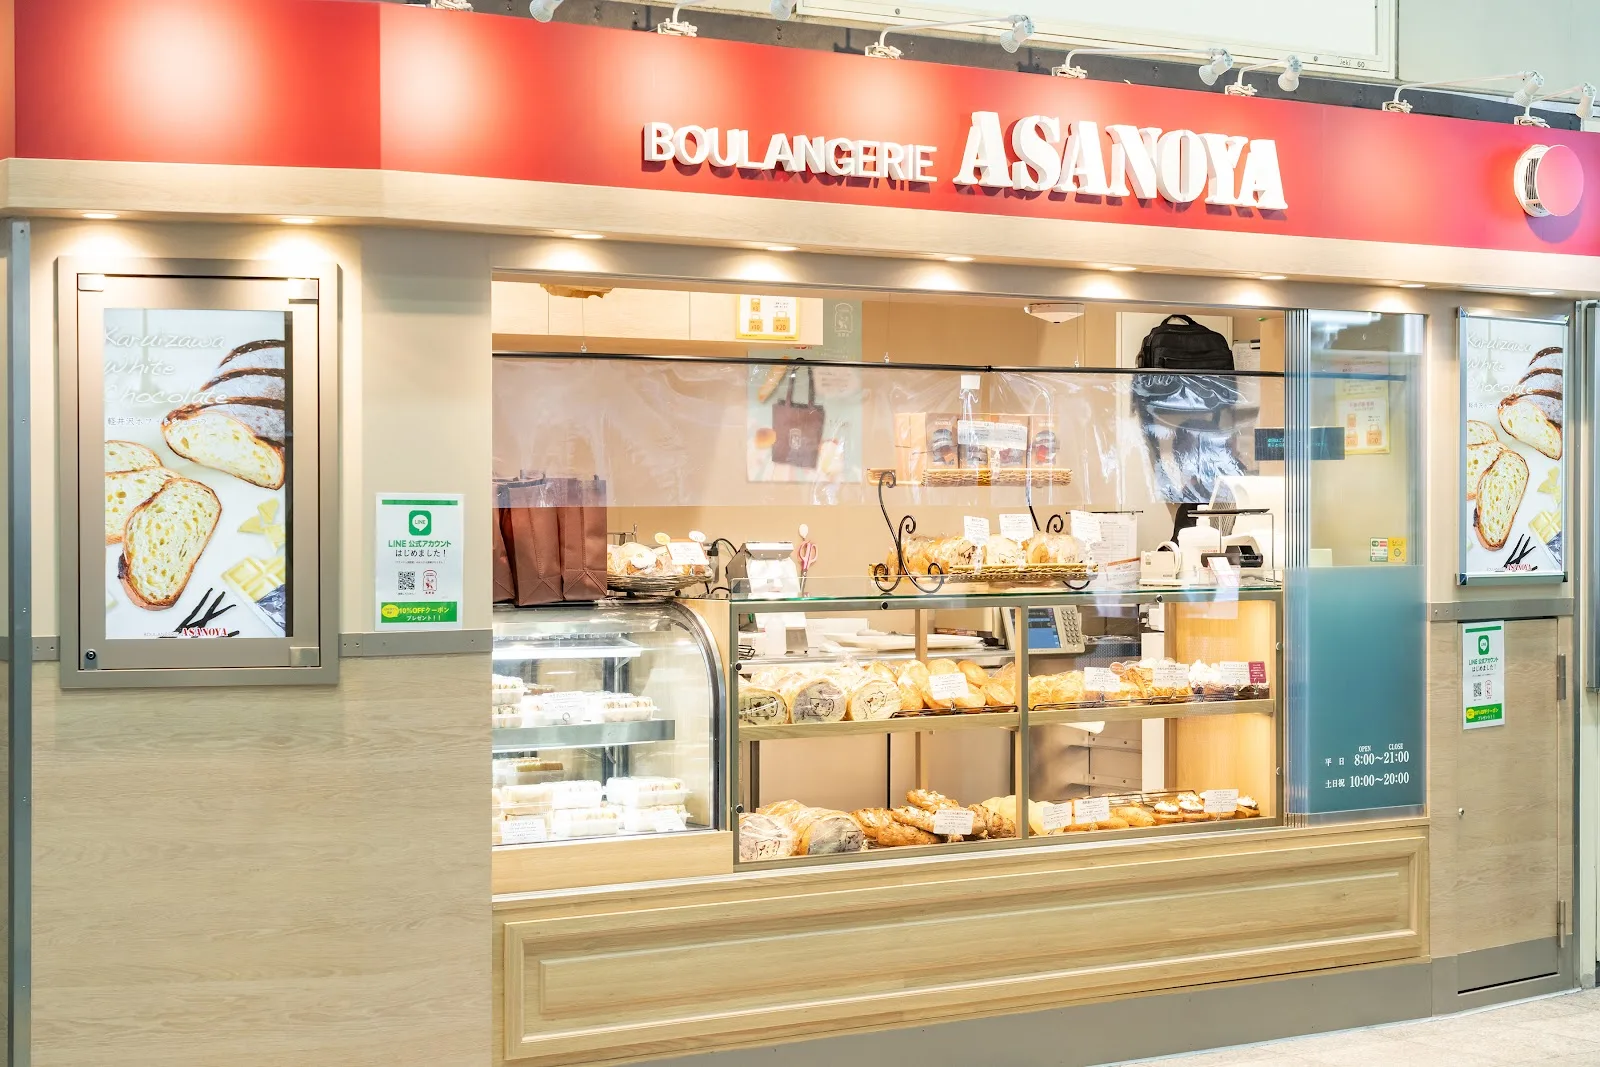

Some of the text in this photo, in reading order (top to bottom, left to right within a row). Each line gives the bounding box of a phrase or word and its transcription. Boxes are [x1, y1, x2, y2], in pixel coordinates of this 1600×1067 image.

[643, 111, 1289, 210] BOULANGERIE ASANOYA
[104, 327, 225, 349] Karuizawa
[104, 356, 176, 376] White
[388, 540, 452, 548] LINE 公式アカウント
[395, 549, 446, 558] はじめました！
[181, 627, 228, 637] ASANOYA
[1325, 779, 1345, 788] 土日祝
